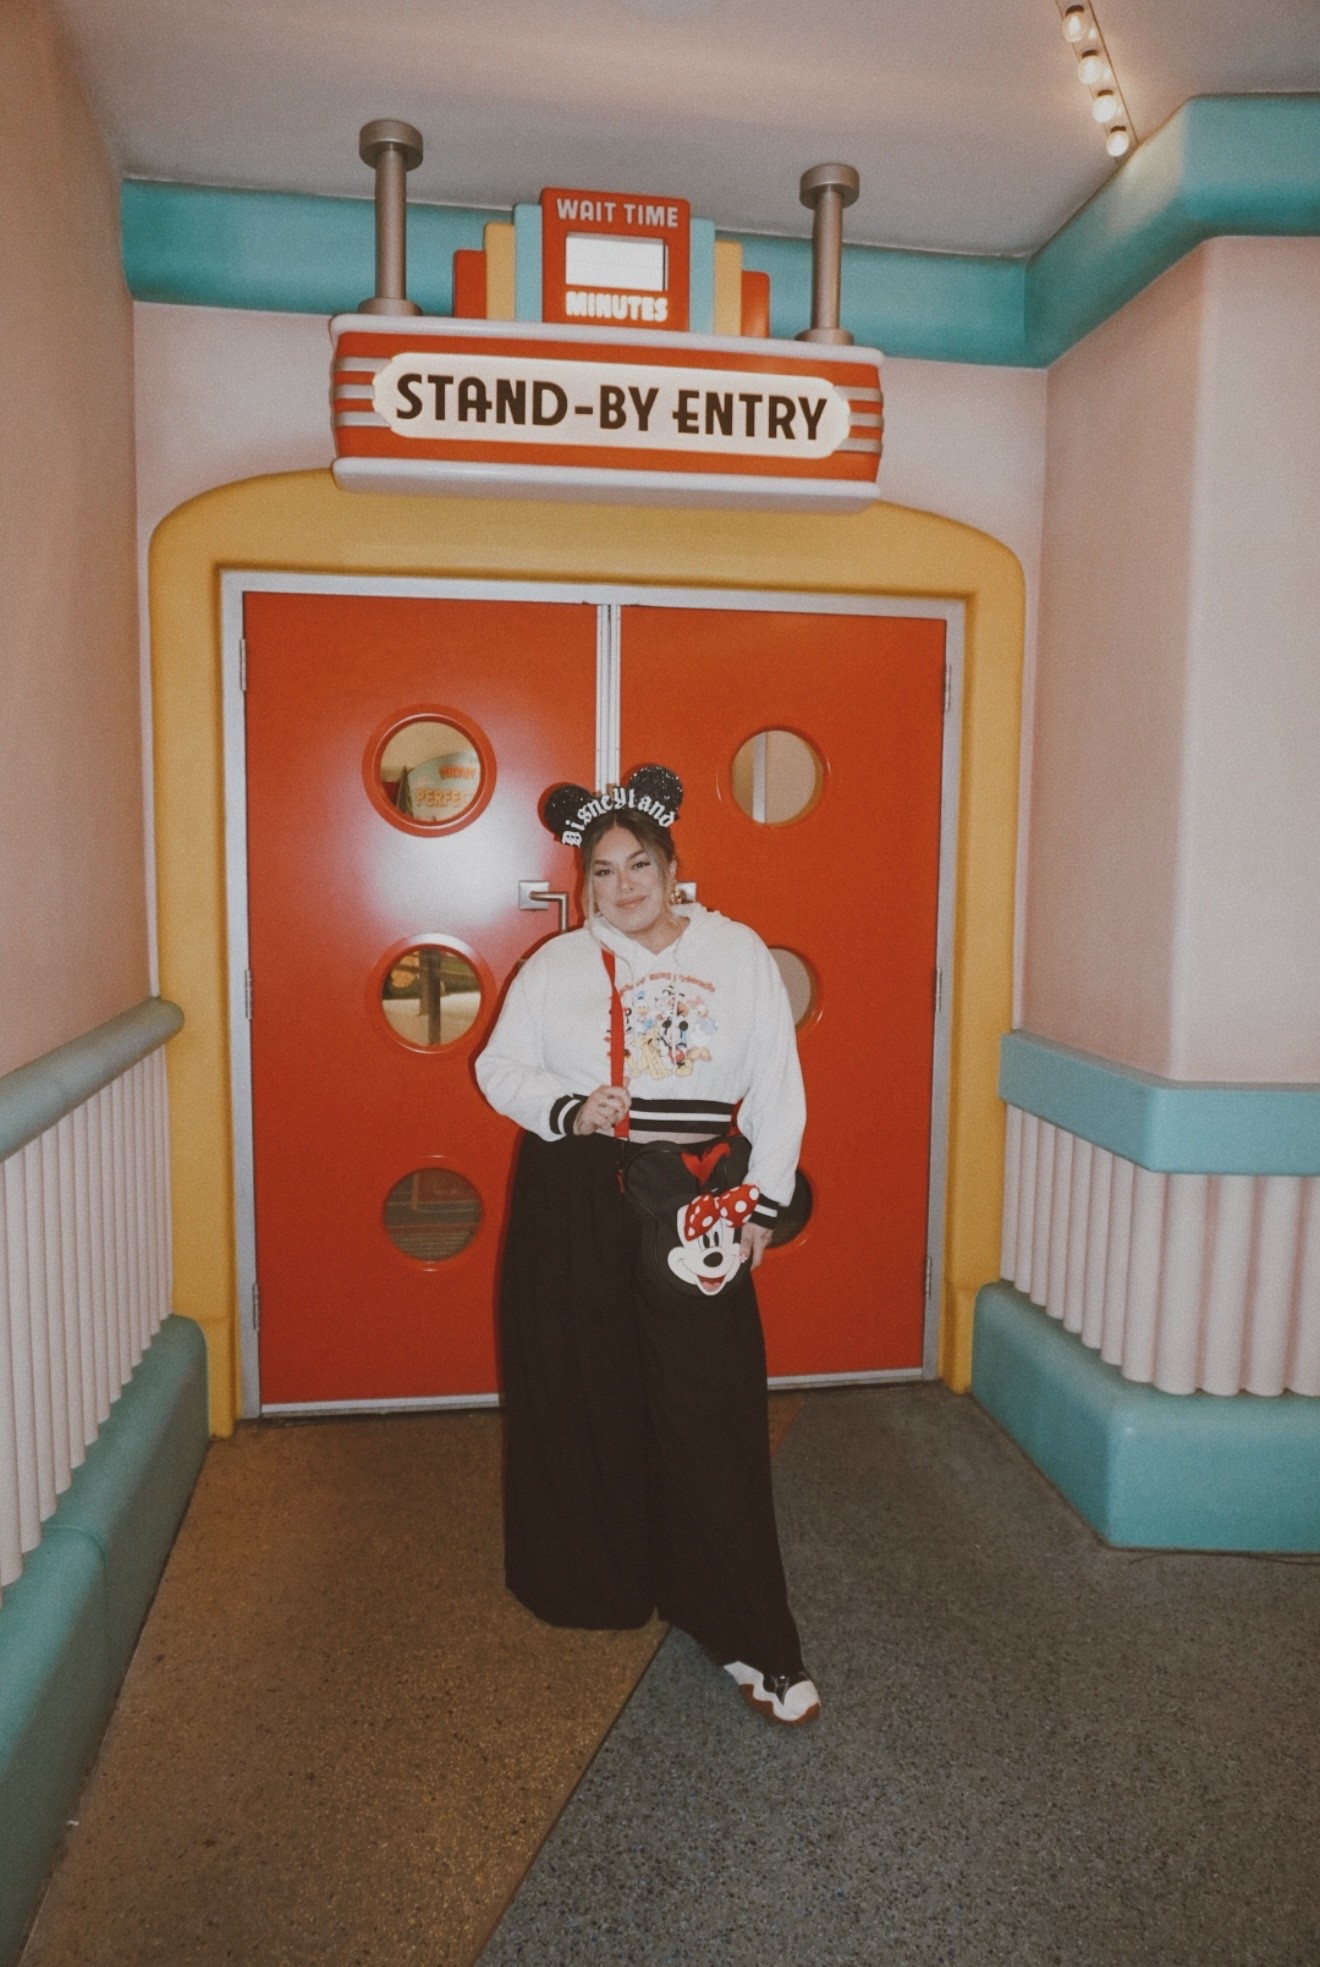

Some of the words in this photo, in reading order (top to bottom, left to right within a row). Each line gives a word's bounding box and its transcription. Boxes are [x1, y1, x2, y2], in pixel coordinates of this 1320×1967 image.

[556, 198, 616, 223] WAIT
[624, 203, 678, 228] TIME
[565, 291, 668, 323] MINUTES
[396, 372, 659, 432] STAND-BY
[672, 389, 828, 440] ENTRY
[562, 786, 676, 848] Disneyland
